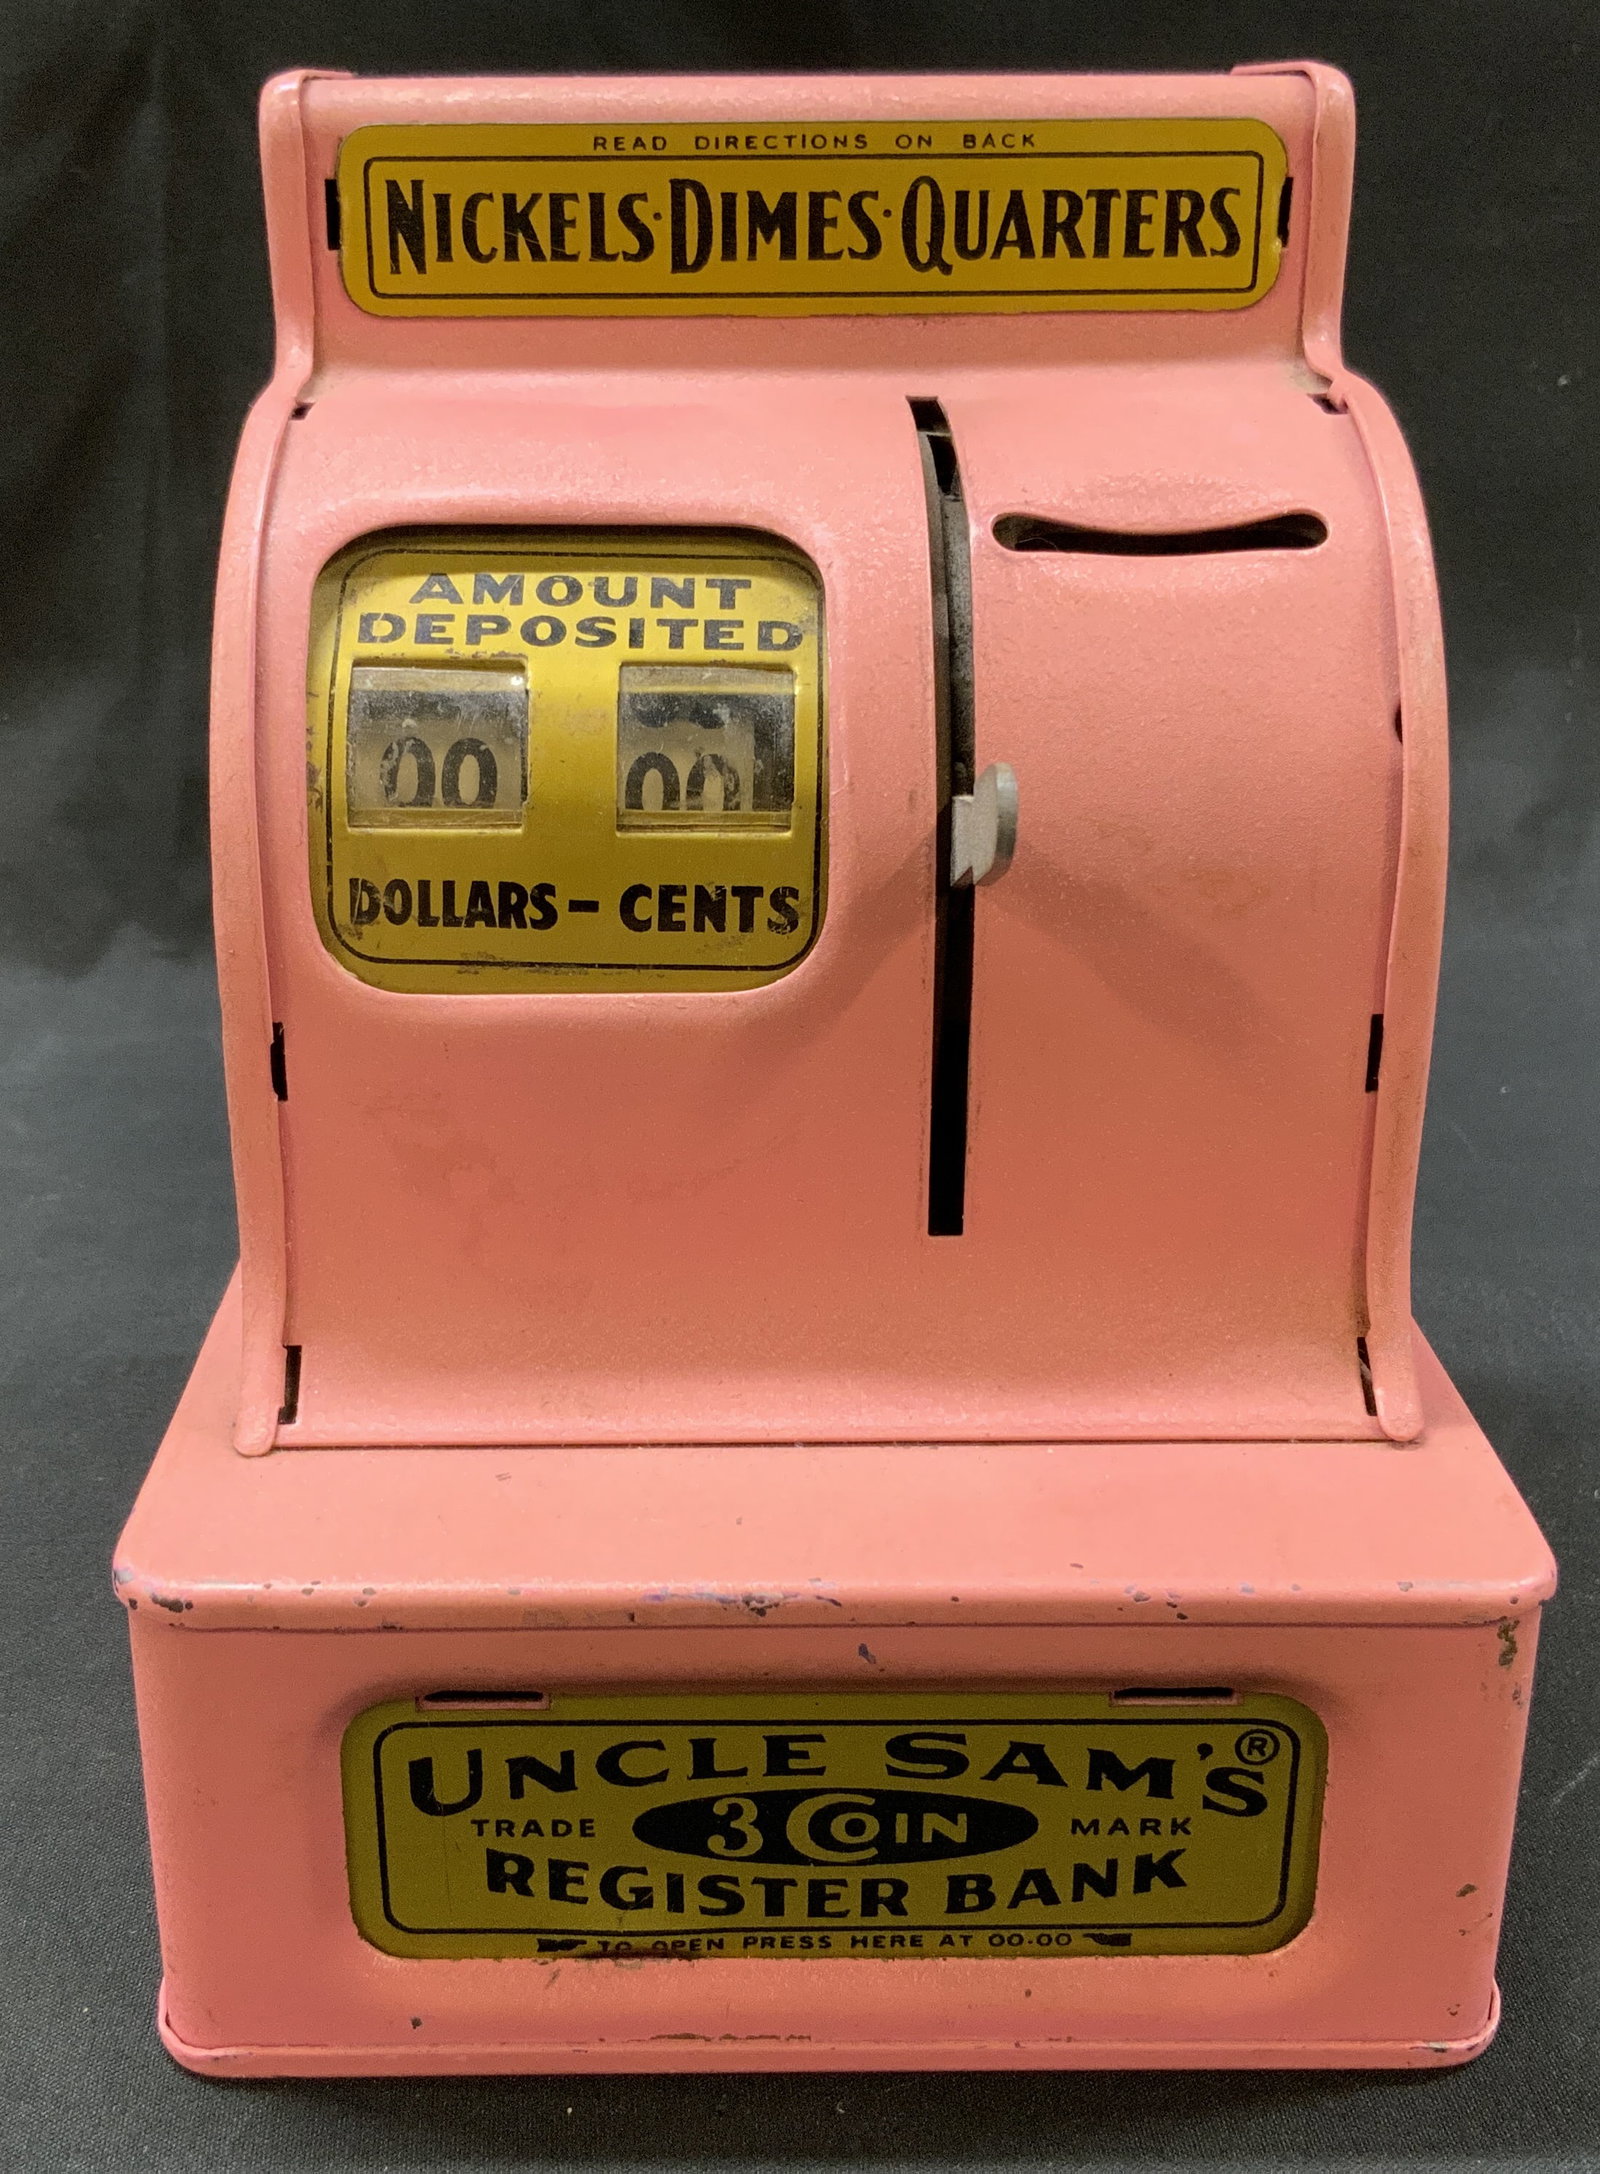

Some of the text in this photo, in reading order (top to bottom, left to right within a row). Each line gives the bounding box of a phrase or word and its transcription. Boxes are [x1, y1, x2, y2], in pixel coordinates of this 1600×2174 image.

[594, 133, 1035, 152] READ DIRECTIONS ON BACK
[409, 572, 752, 610] AMOUNT
[357, 612, 804, 652] DEPOSITED
[379, 736, 498, 809] 00
[619, 884, 801, 936] CENTS
[408, 1733, 827, 1817] UNCLE
[885, 1731, 1268, 1818] SAM'S
[471, 1792, 1192, 1863] TRADE 3 COIN MARK
[485, 1847, 1188, 1918] REGISTER BANK
[651, 1937, 725, 1953] OPEN
[742, 1935, 832, 1950] PRESS
[850, 1933, 924, 1949] HERE
[938, 1933, 973, 1948] AT
